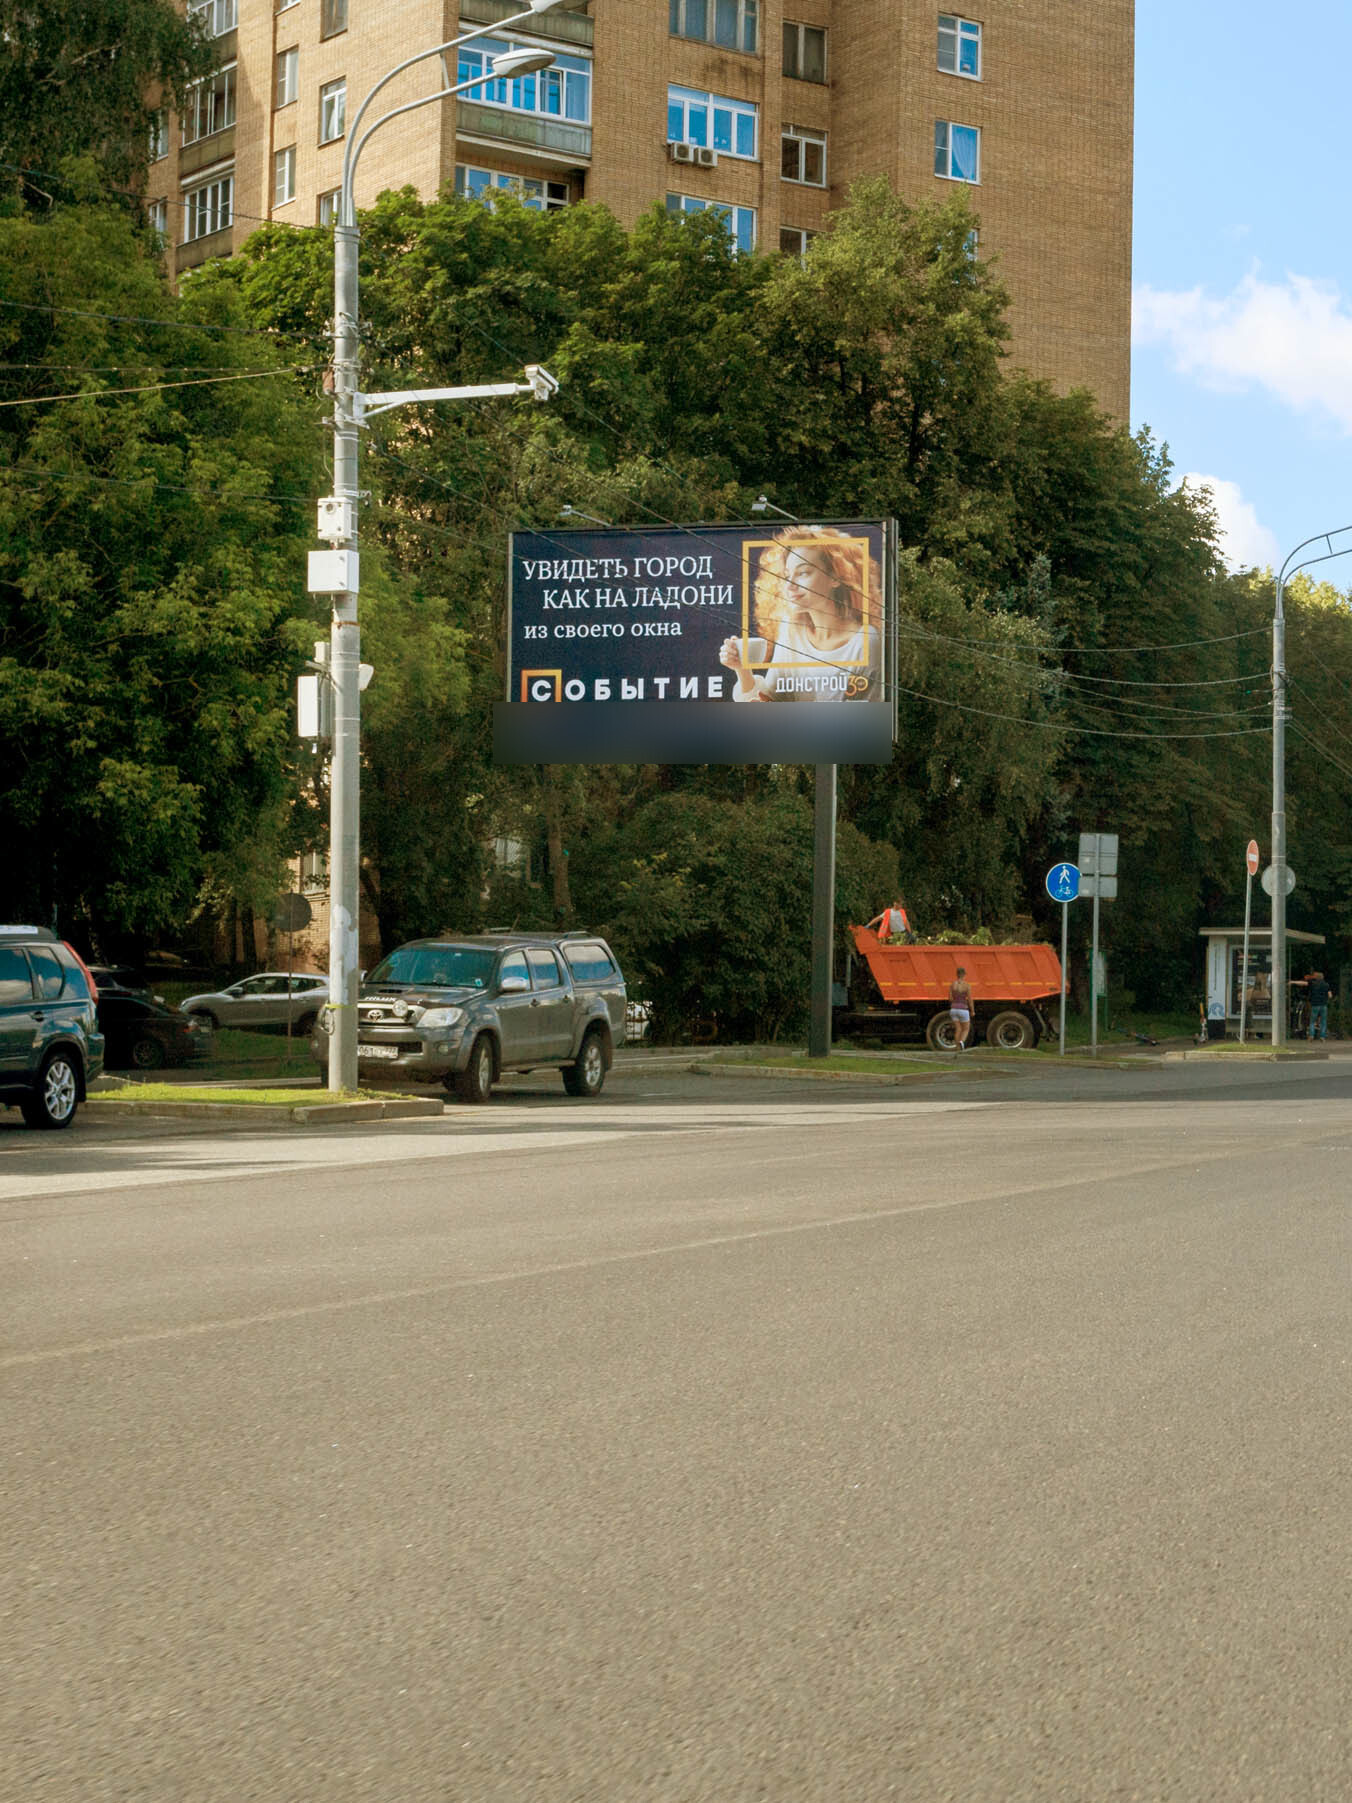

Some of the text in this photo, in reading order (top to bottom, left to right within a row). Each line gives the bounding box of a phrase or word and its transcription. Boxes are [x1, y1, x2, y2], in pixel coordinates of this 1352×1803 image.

[523, 556, 712, 582] УВИДЕТЬ ГОРОД
[543, 585, 733, 611] КАК НА ЛАДОНИ
[525, 622, 682, 639] из своего окна
[531, 676, 724, 702] СОБЫТИЕ
[775, 674, 847, 694] ДОНСТРОЙ
